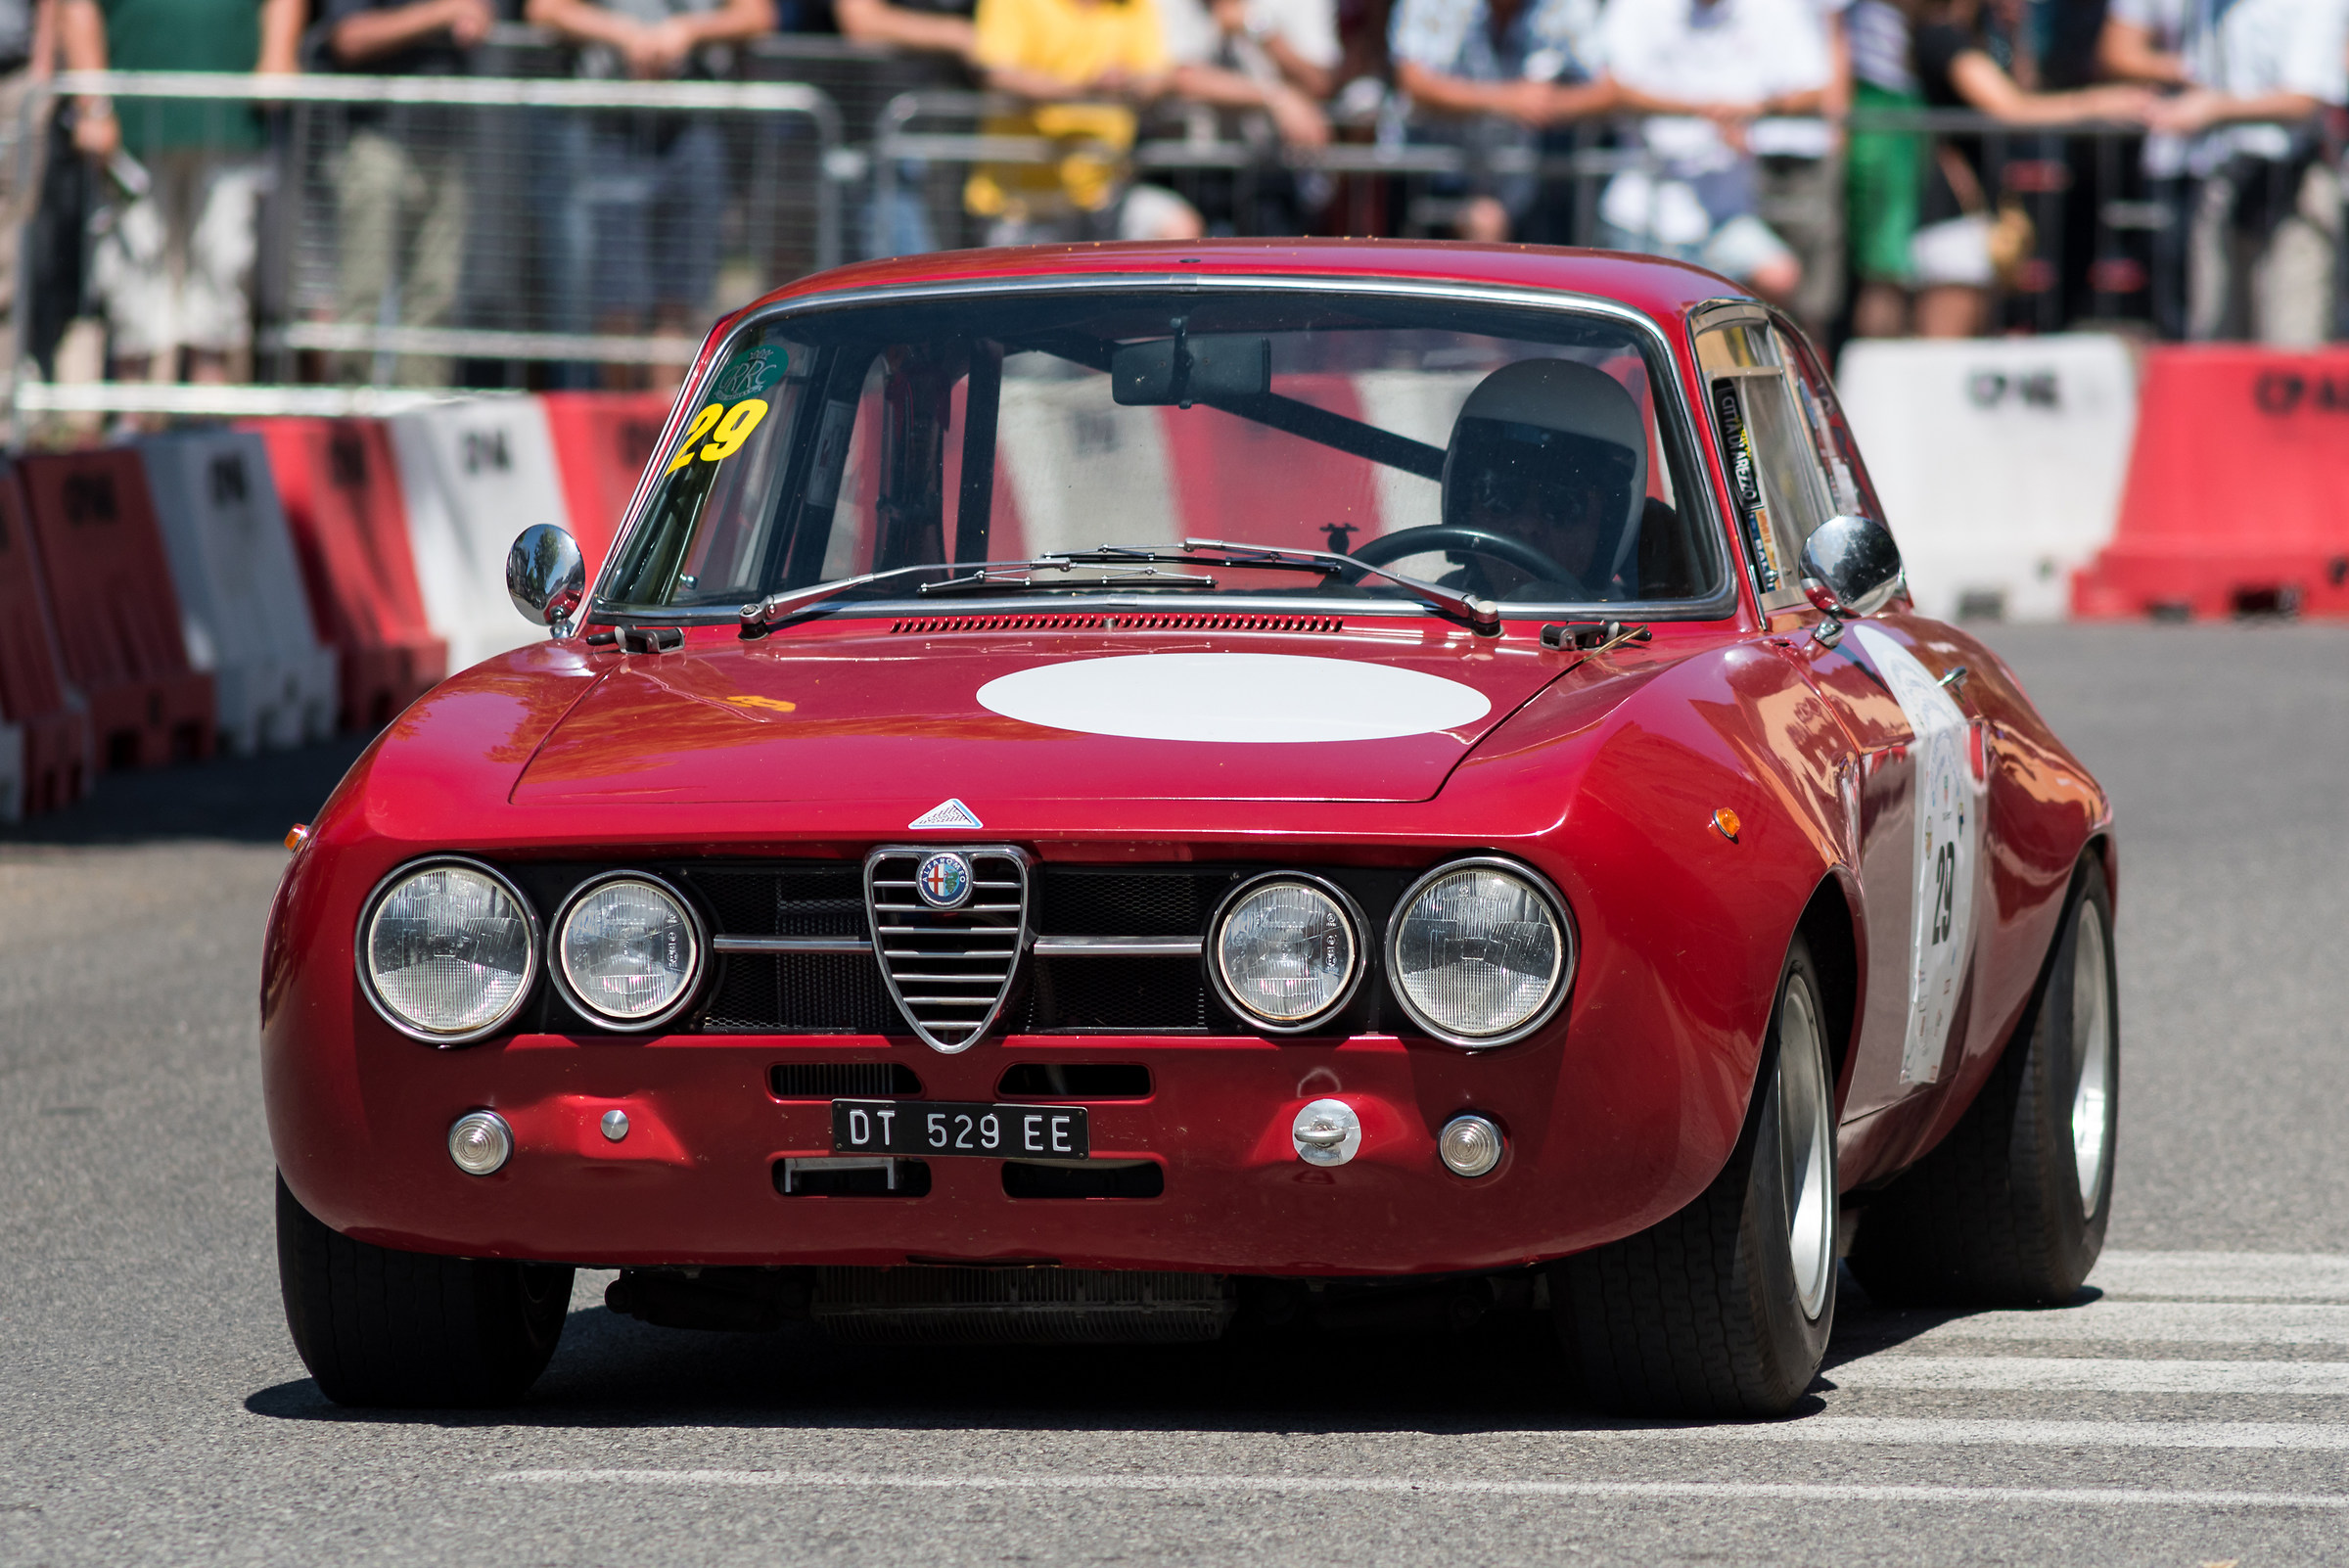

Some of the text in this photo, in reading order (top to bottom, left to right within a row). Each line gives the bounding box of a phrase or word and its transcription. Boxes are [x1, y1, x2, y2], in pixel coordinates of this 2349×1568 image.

[664, 398, 768, 478] 29
[1729, 449, 1758, 501] AREZZO
[1932, 841, 1955, 945] 29
[850, 1109, 1073, 1152] DT 529 EE
